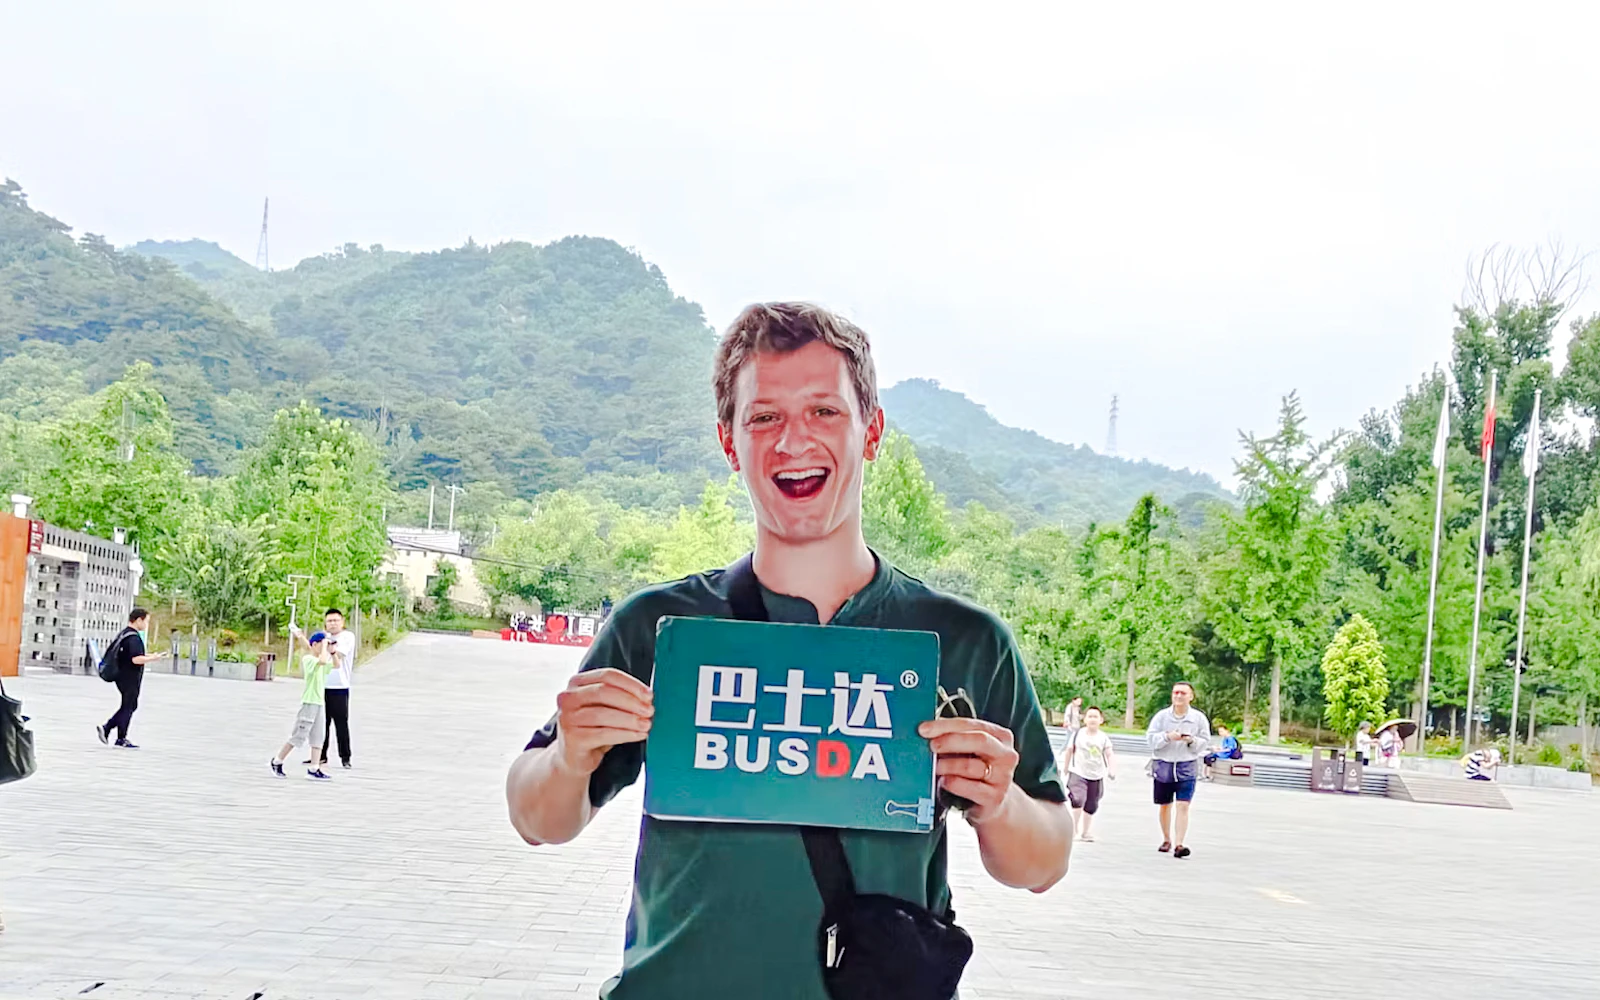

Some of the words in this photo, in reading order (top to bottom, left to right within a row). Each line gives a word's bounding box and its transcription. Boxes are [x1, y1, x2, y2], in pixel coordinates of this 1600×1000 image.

[694, 665, 895, 738] 巴士达
[693, 732, 891, 781] BUSDA
